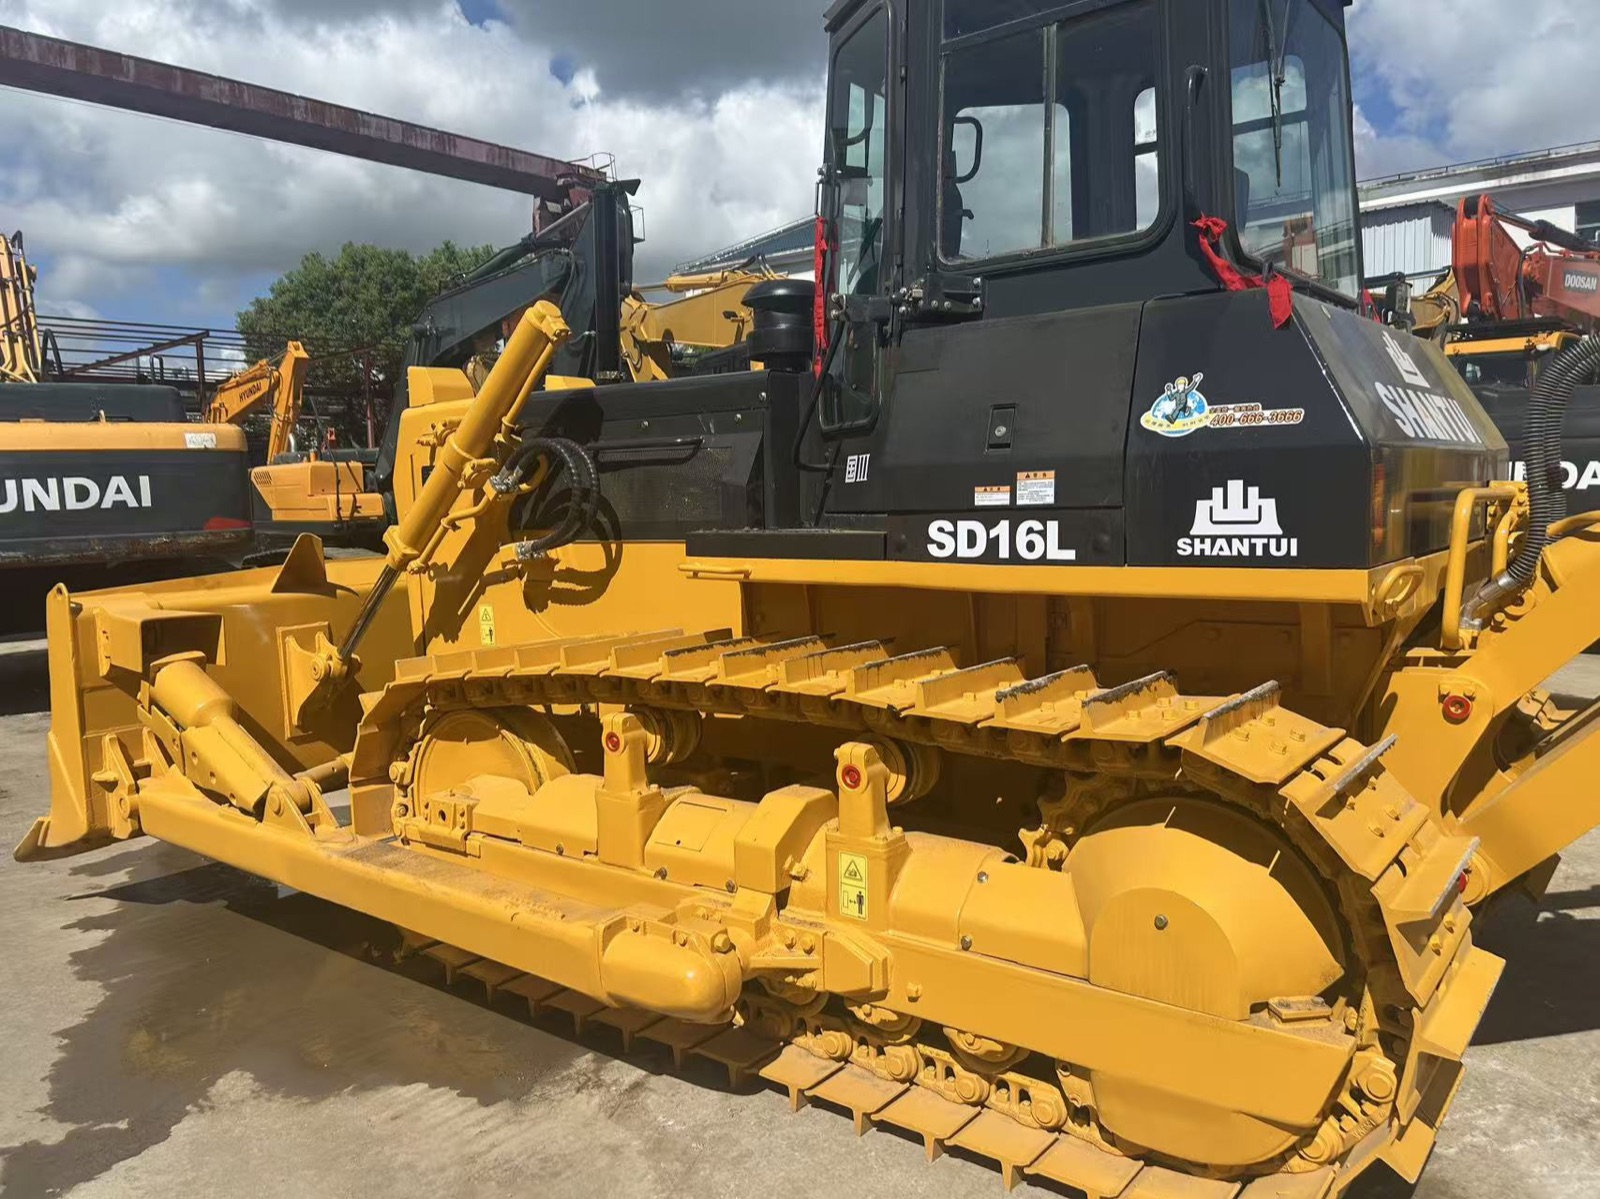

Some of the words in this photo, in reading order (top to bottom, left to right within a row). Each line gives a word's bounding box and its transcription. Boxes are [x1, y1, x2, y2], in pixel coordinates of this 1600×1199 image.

[1565, 274, 1597, 290] DOOSAN
[239, 381, 262, 402] HYUNDAI
[1210, 410, 1302, 427] 400-666-3666
[1375, 381, 1482, 443] SHANTUI
[927, 519, 1076, 560] SD16L
[1176, 537, 1298, 557] SHANTUI
